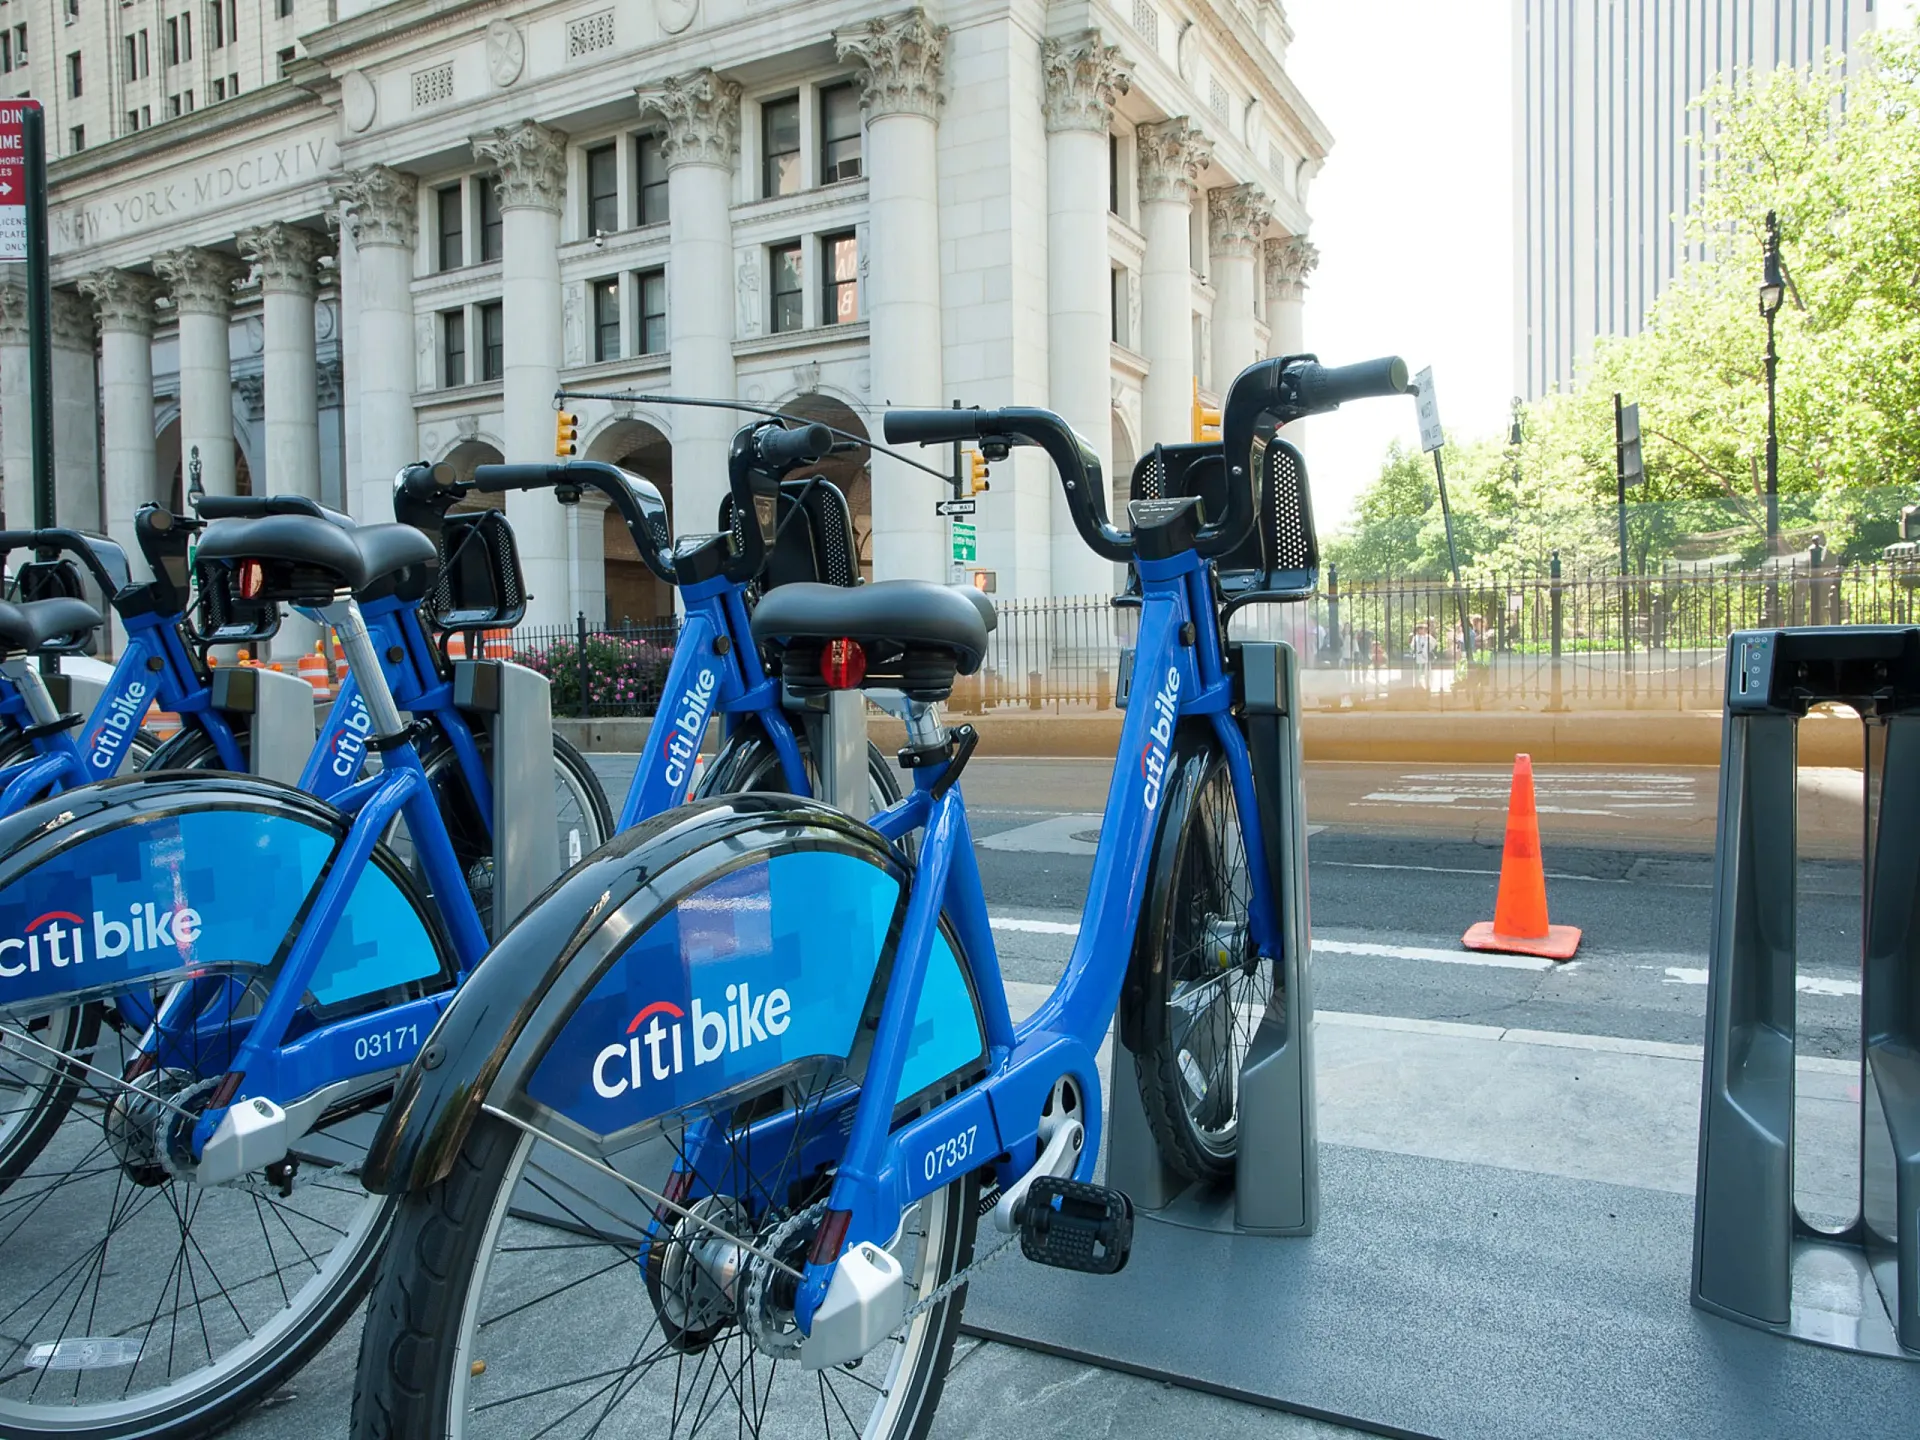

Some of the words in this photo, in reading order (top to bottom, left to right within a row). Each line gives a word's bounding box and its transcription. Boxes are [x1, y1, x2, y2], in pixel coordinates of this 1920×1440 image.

[0, 109, 24, 124] DIN
[56, 206, 101, 244] NEW
[113, 185, 178, 228] YORK
[194, 137, 327, 203] MDCLXIV
[5, 242, 27, 251] ONLY
[942, 504, 955, 512] ONE
[104, 682, 146, 731] bike
[344, 694, 371, 734] bi
[675, 668, 715, 737] bike
[1150, 666, 1180, 747] bike
[91, 727, 123, 768] citi
[331, 729, 364, 777] citi
[663, 730, 694, 787] citi
[1141, 741, 1166, 811] citi
[0, 911, 85, 978] citi
[93, 902, 202, 960] bike
[354, 1023, 418, 1061] 03171
[592, 1001, 685, 1099] citi
[691, 982, 792, 1067] bike
[924, 1124, 977, 1181] 07337
